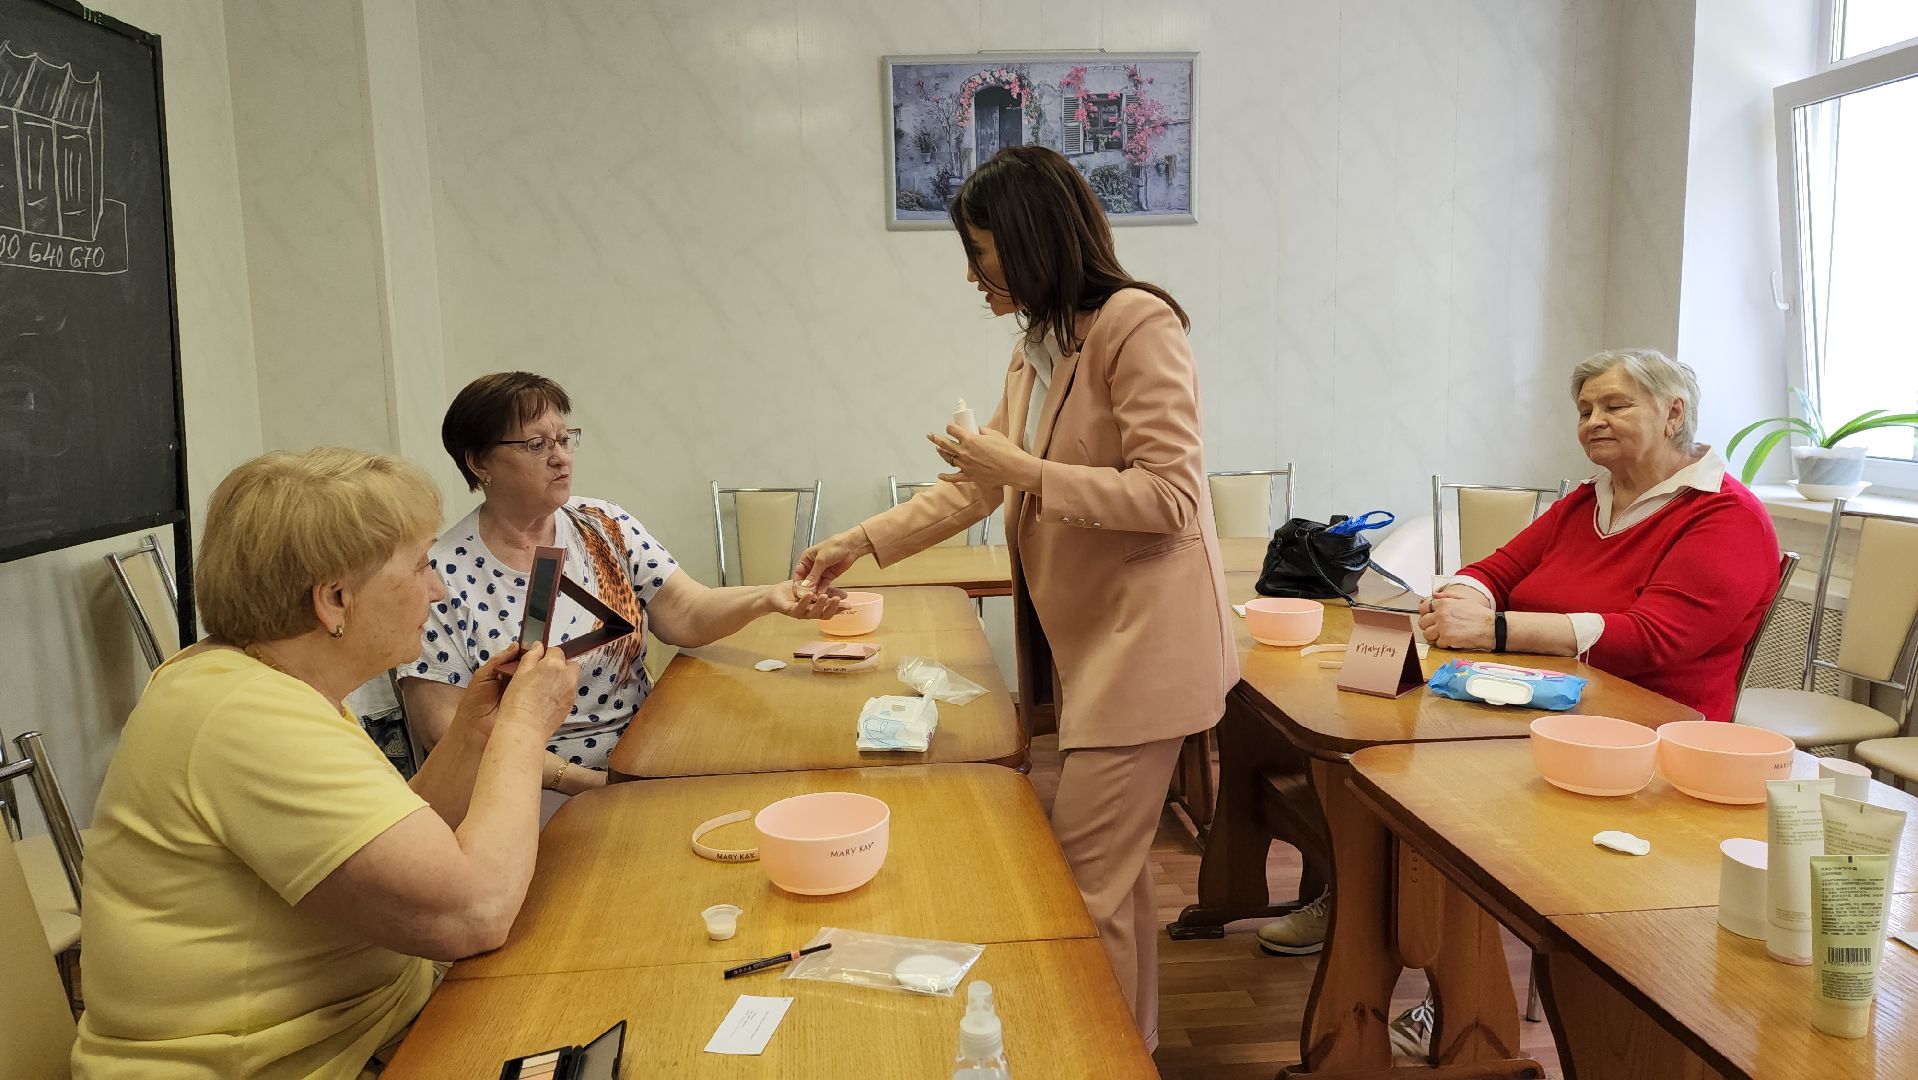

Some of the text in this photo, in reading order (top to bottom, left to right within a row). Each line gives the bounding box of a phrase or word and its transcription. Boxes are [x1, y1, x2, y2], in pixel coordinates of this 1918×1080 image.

[29, 242, 63, 268] 640
[70, 246, 105, 269] 670
[716, 852, 755, 861] MARY KAY
[830, 841, 875, 858] MARY KAY
